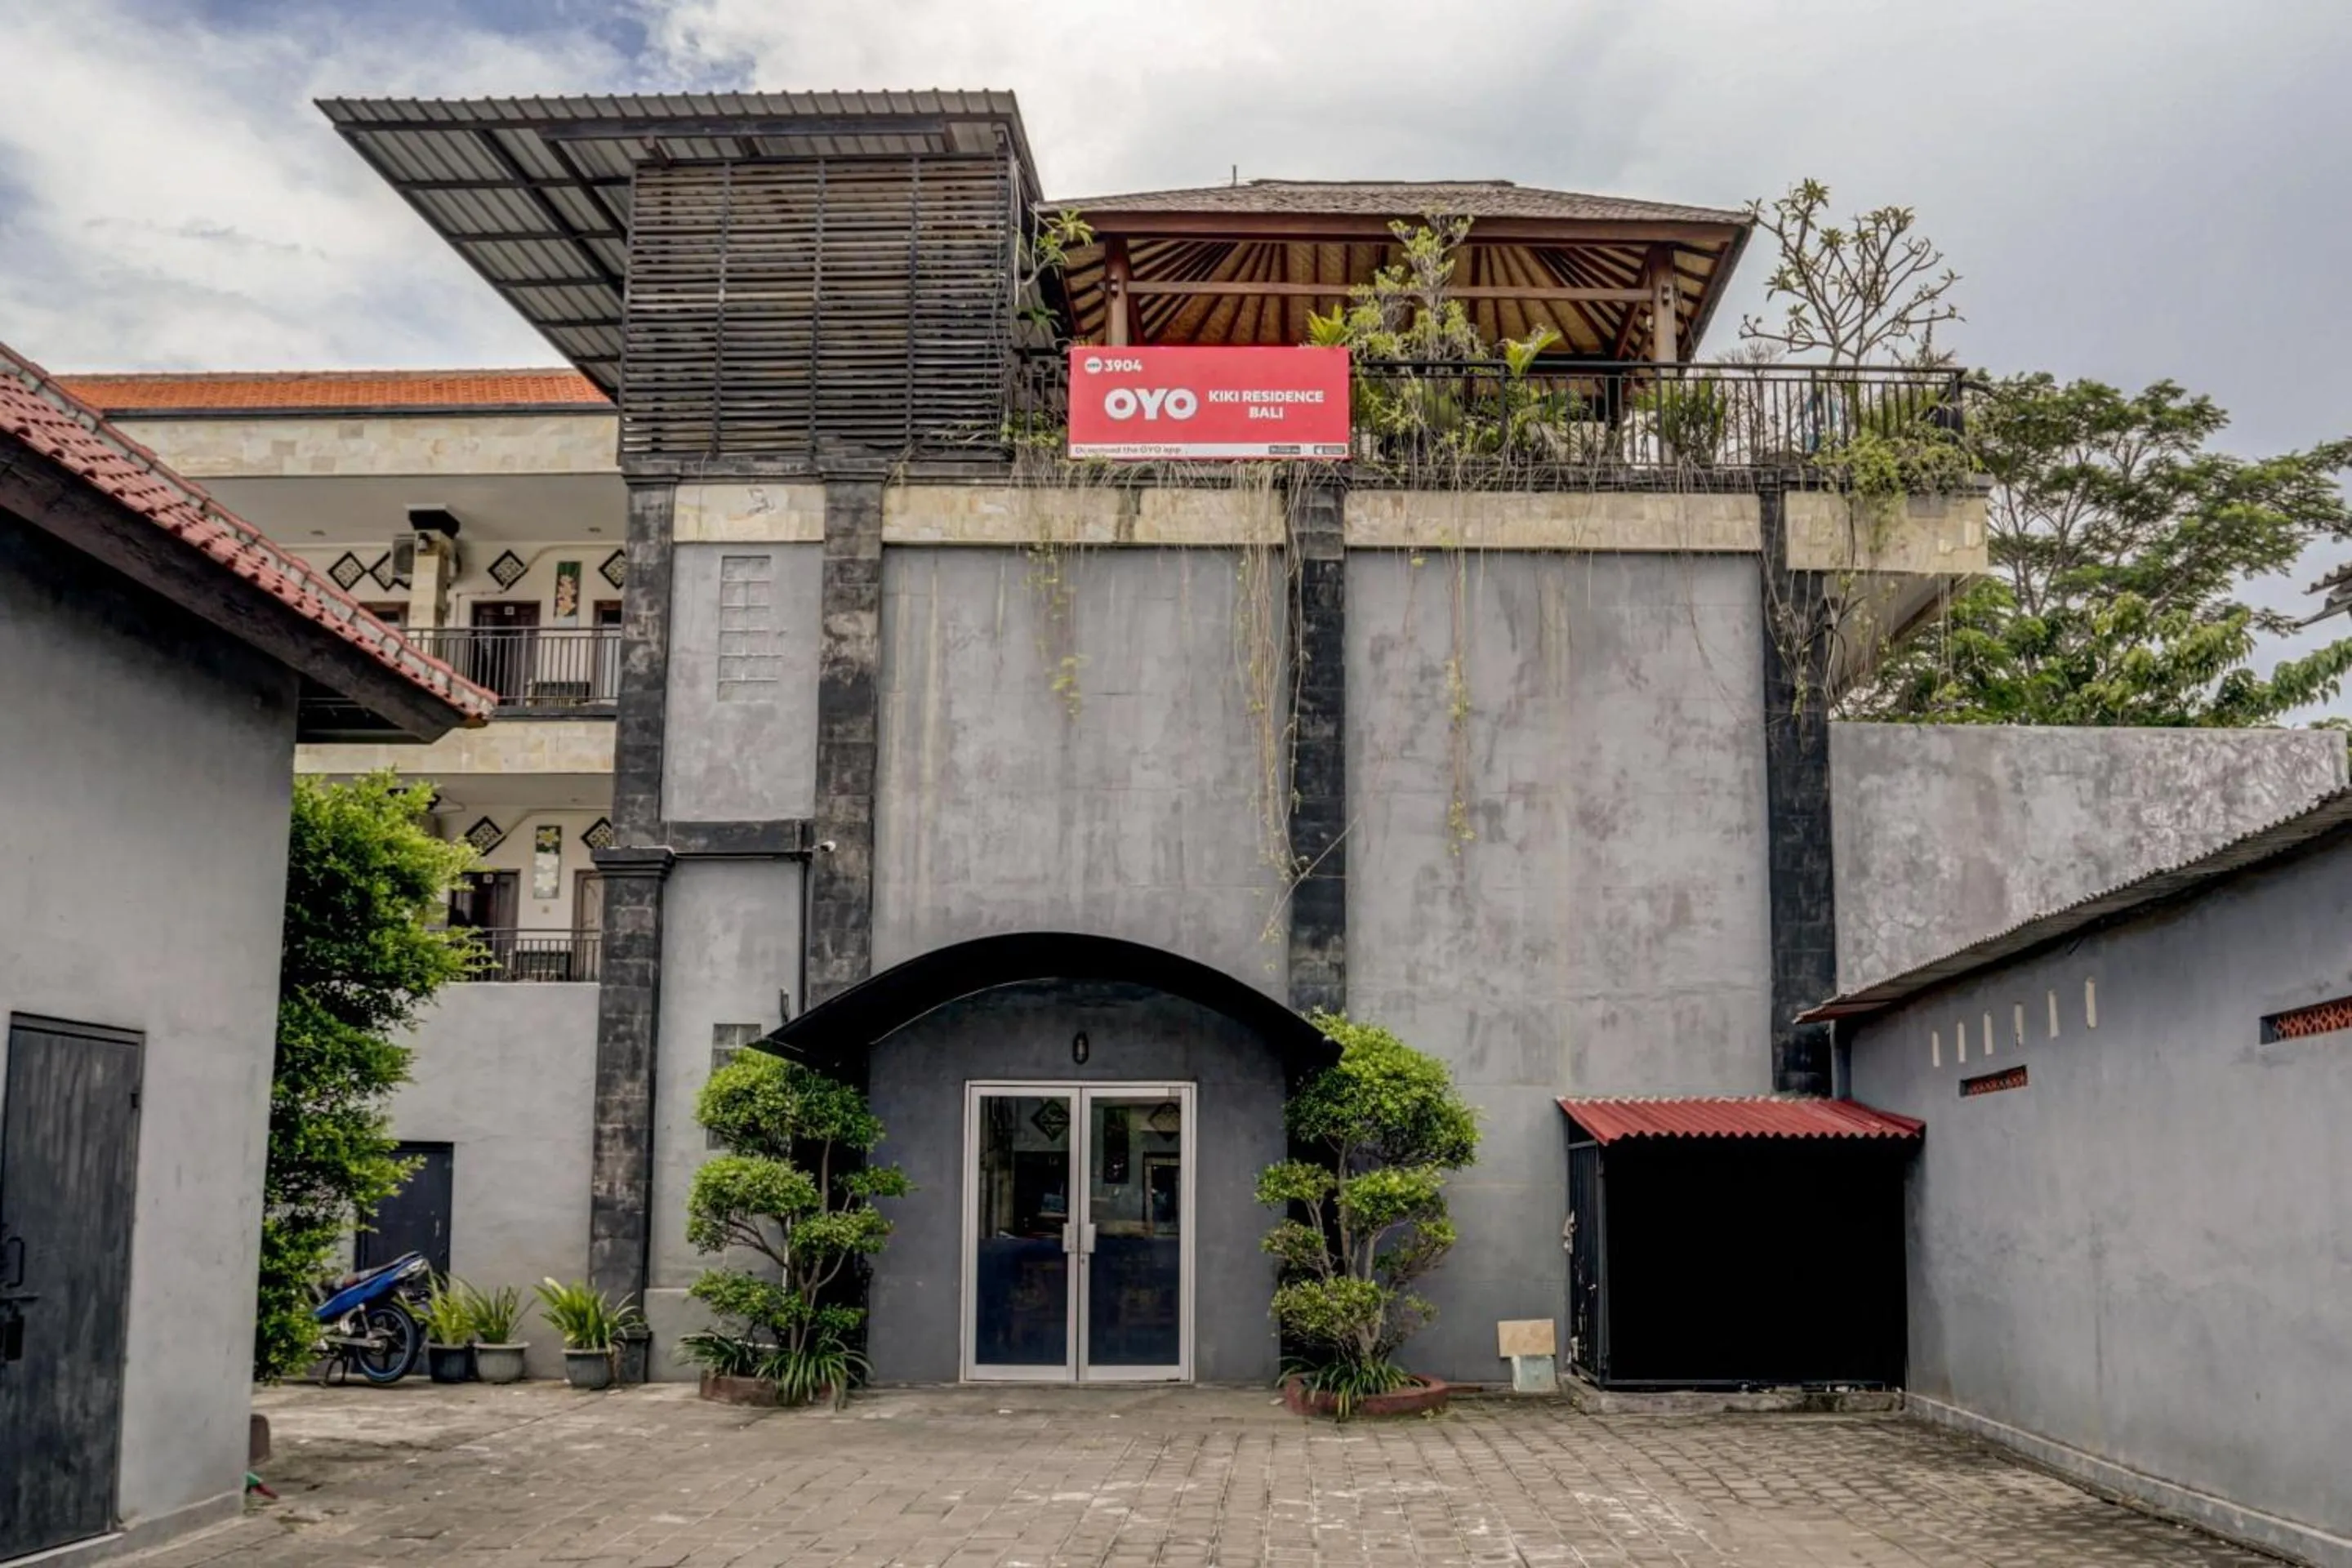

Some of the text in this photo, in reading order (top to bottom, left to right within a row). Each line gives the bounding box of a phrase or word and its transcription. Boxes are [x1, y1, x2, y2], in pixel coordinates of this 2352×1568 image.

[1104, 359, 1143, 372] 3904
[1209, 390, 1325, 403] KIKI RESIDENCE
[1104, 388, 1198, 420] OYO
[1249, 406, 1284, 419] BALI
[1139, 446, 1162, 454] OYO
